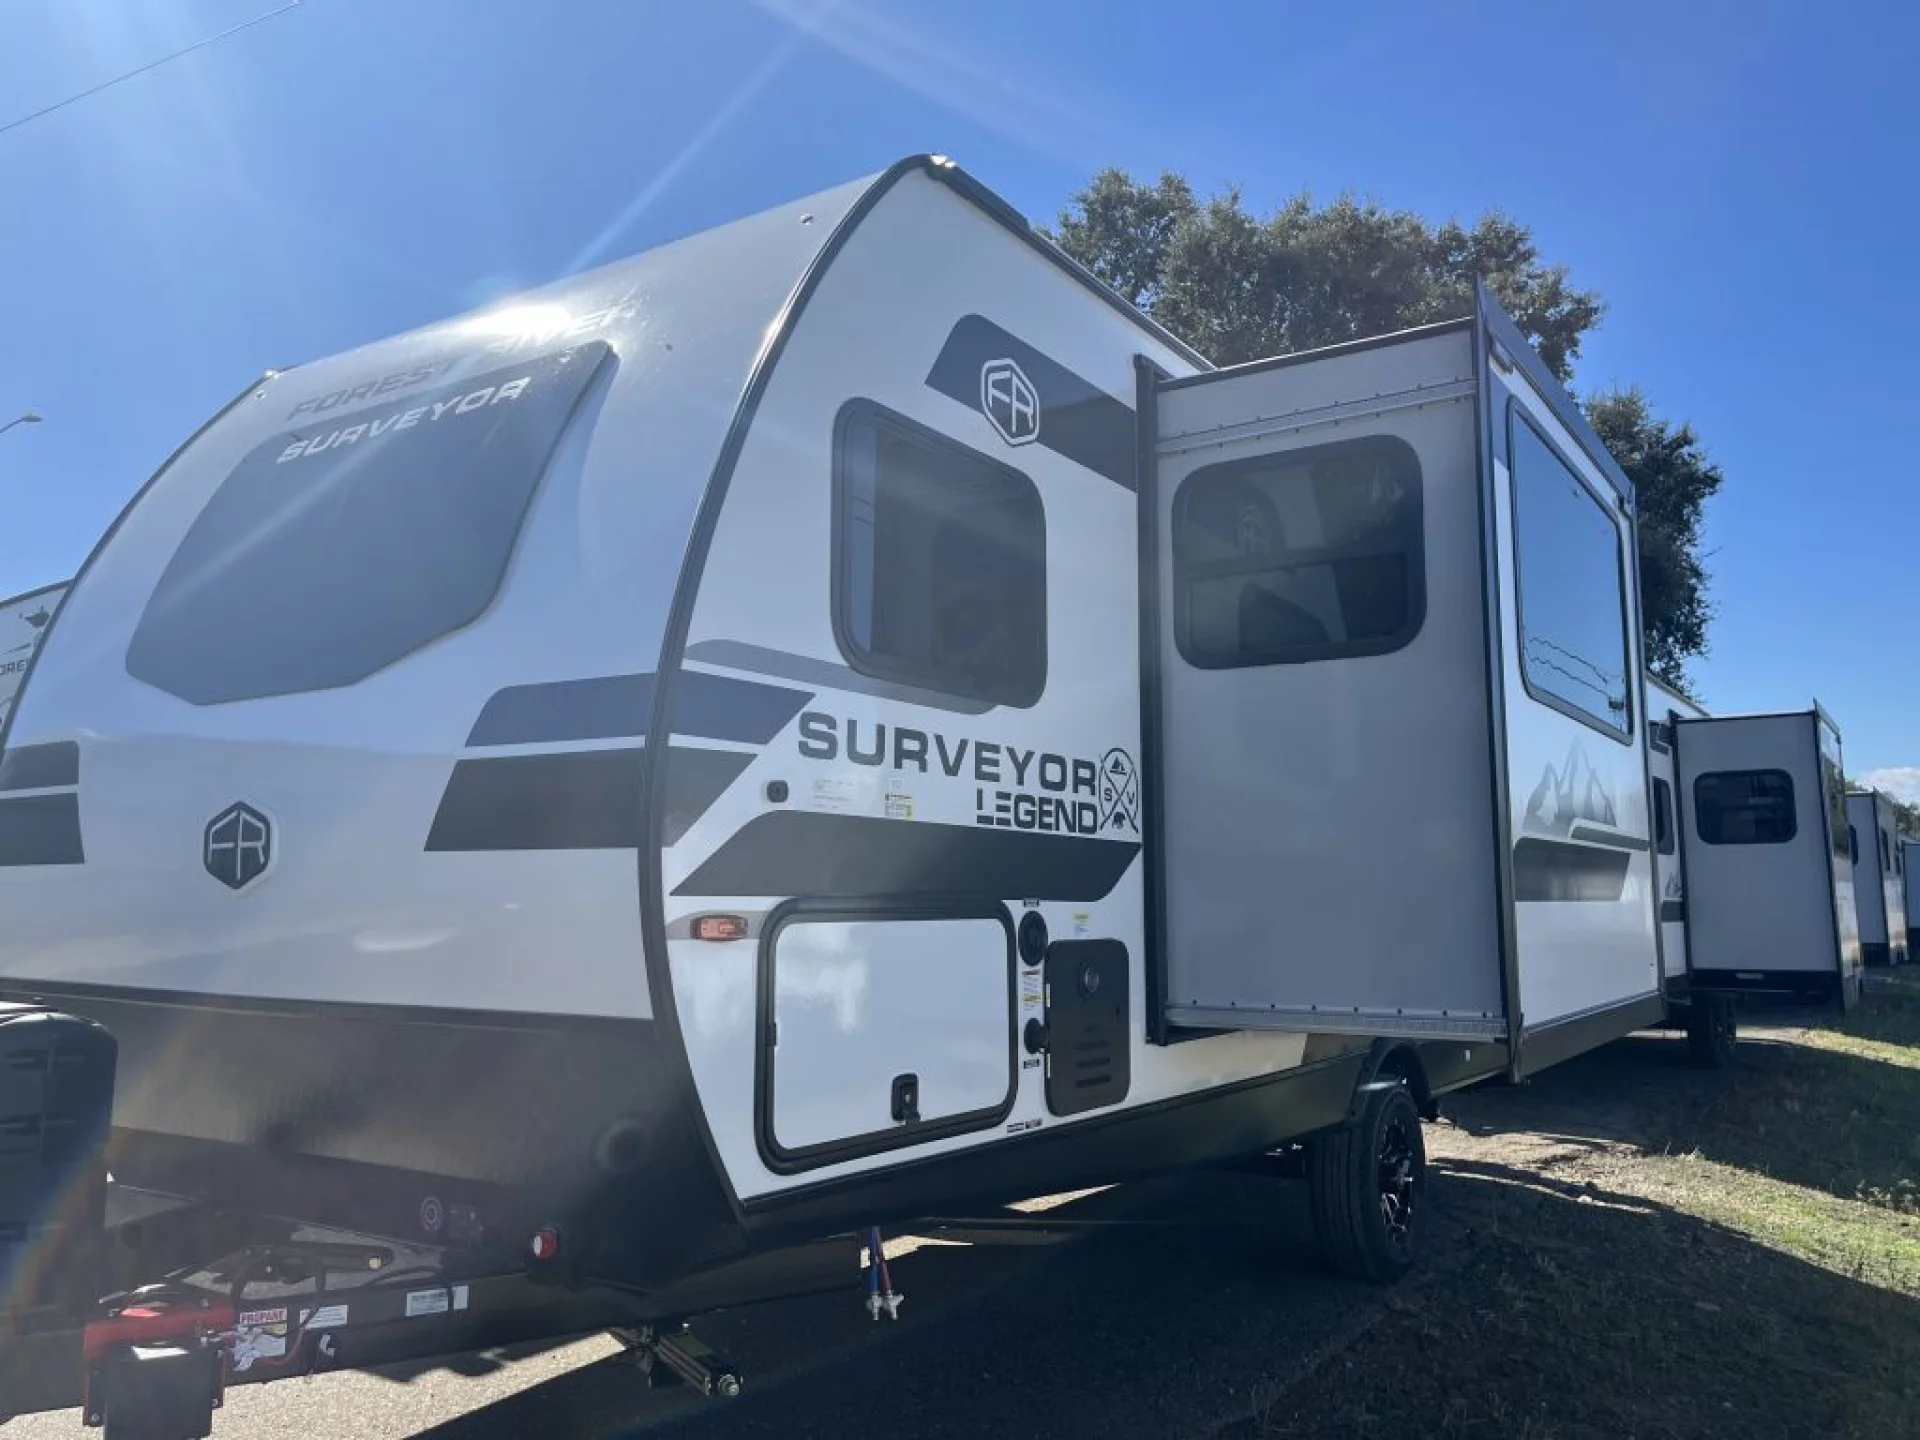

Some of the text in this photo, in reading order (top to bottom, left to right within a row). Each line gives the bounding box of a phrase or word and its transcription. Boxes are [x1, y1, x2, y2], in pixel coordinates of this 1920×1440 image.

[276, 376, 531, 464] SURVEYOR
[798, 711, 1096, 796] SURVEYOR
[976, 788, 1098, 835] LEGEND
